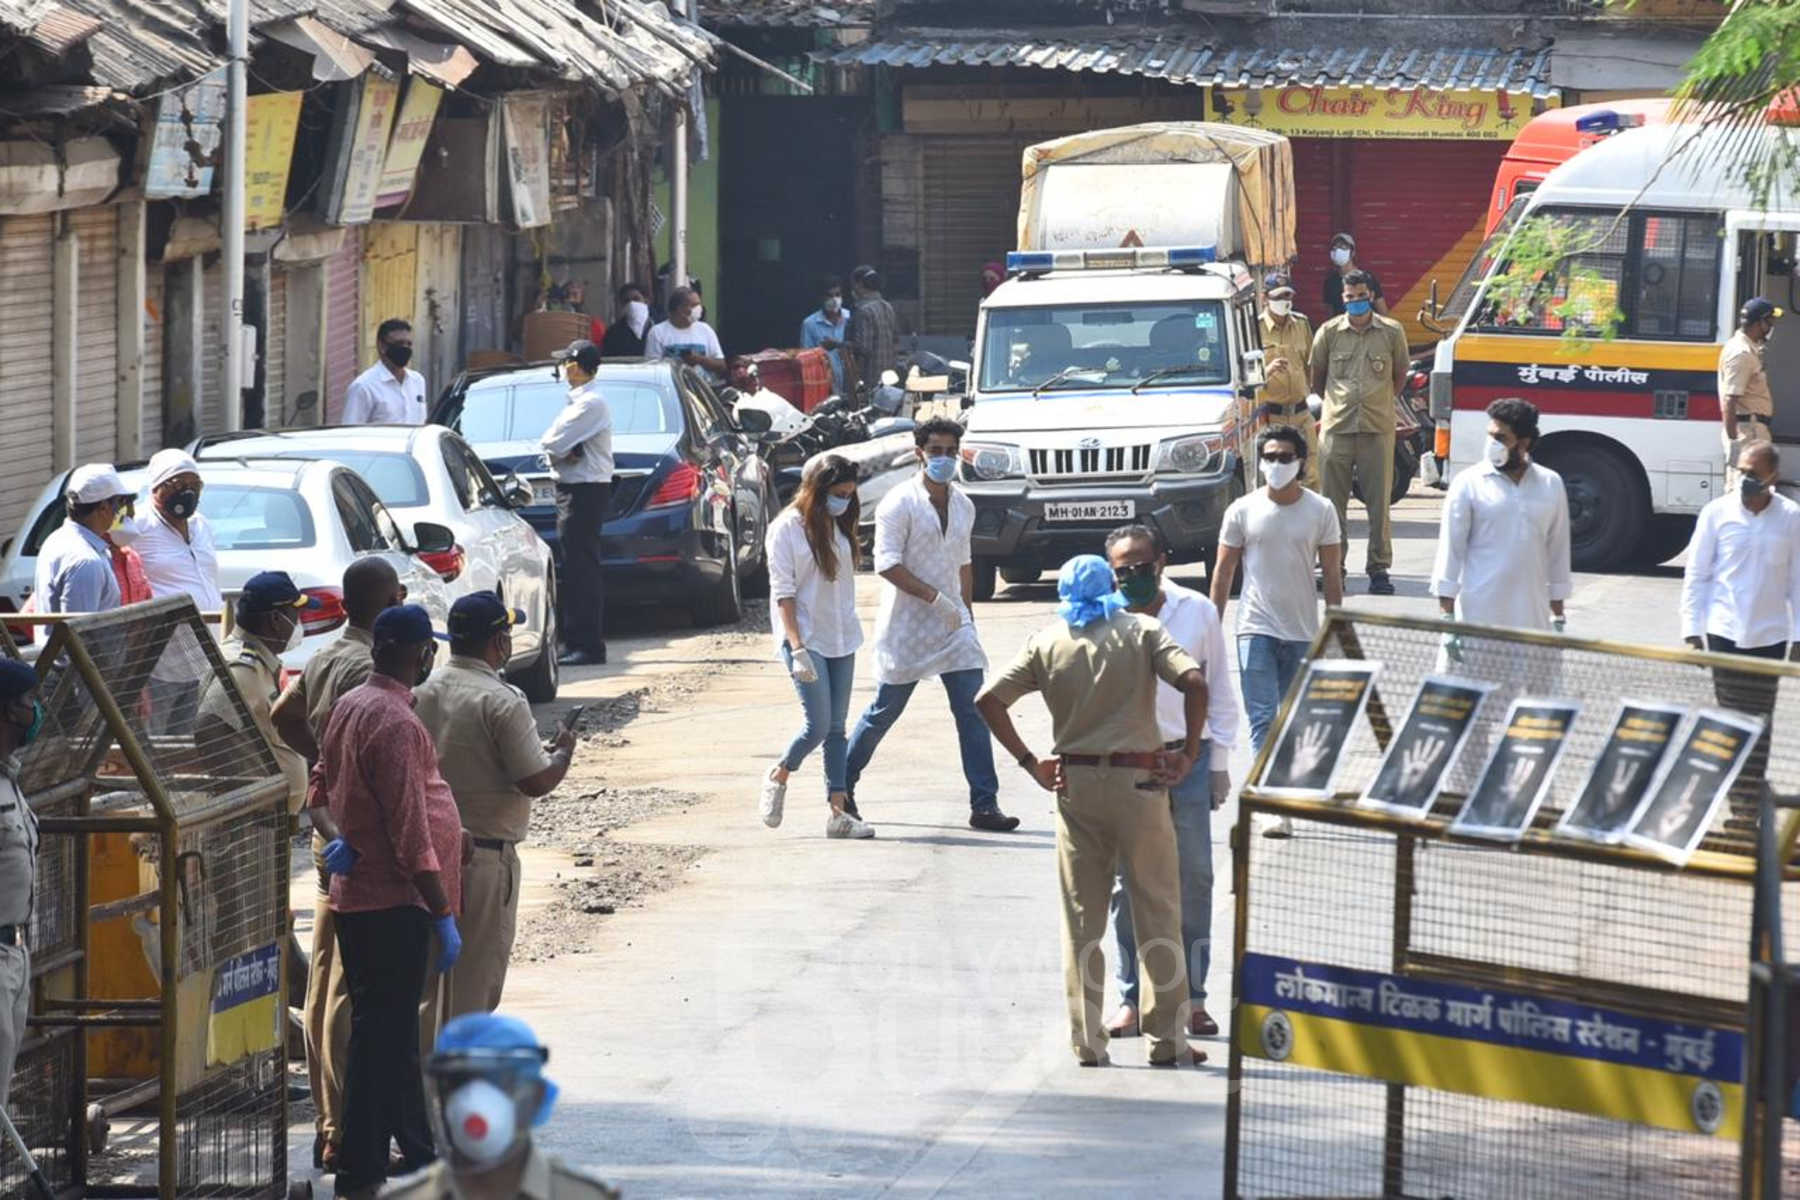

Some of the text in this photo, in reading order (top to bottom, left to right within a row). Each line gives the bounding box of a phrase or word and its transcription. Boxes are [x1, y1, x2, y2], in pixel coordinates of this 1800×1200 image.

[1277, 86, 1488, 129] Chair King
[1518, 363, 1649, 385] मुंबई पोलीस
[1274, 966, 1375, 1012] लोकमान्य
[1379, 980, 1441, 1022] टिळक
[1445, 994, 1494, 1031] मार्ग
[1574, 1011, 1641, 1054] स्टेशन
[1663, 1024, 1716, 1073] मुंबई
